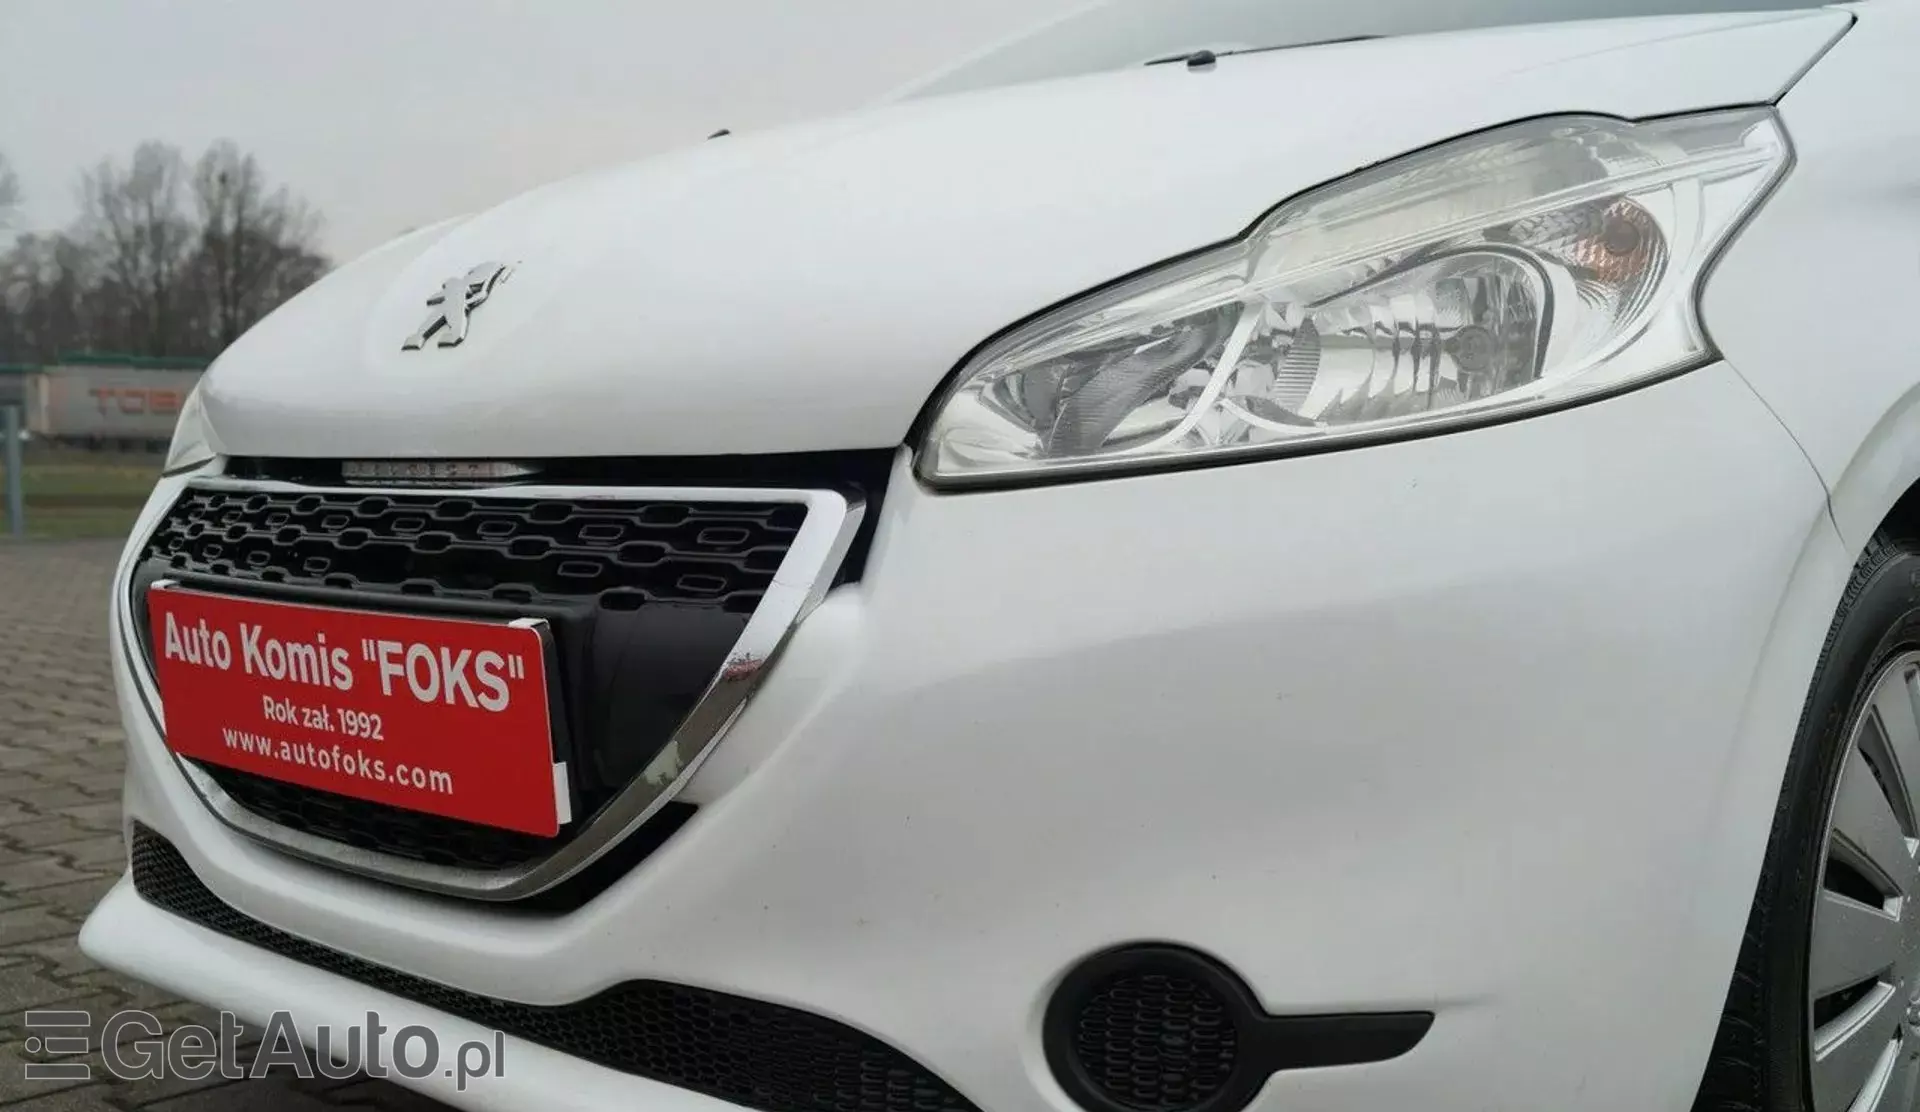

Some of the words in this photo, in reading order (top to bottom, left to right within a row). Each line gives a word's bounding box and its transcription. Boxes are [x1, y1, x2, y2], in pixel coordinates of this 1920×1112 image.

[165, 612, 232, 671] Auto
[240, 622, 353, 691] Komis
[362, 638, 525, 712] "FOKS"
[263, 695, 299, 727] Rok
[301, 706, 334, 732] zał.
[337, 708, 384, 741] 1992
[222, 727, 453, 795] www.autofoks.com
